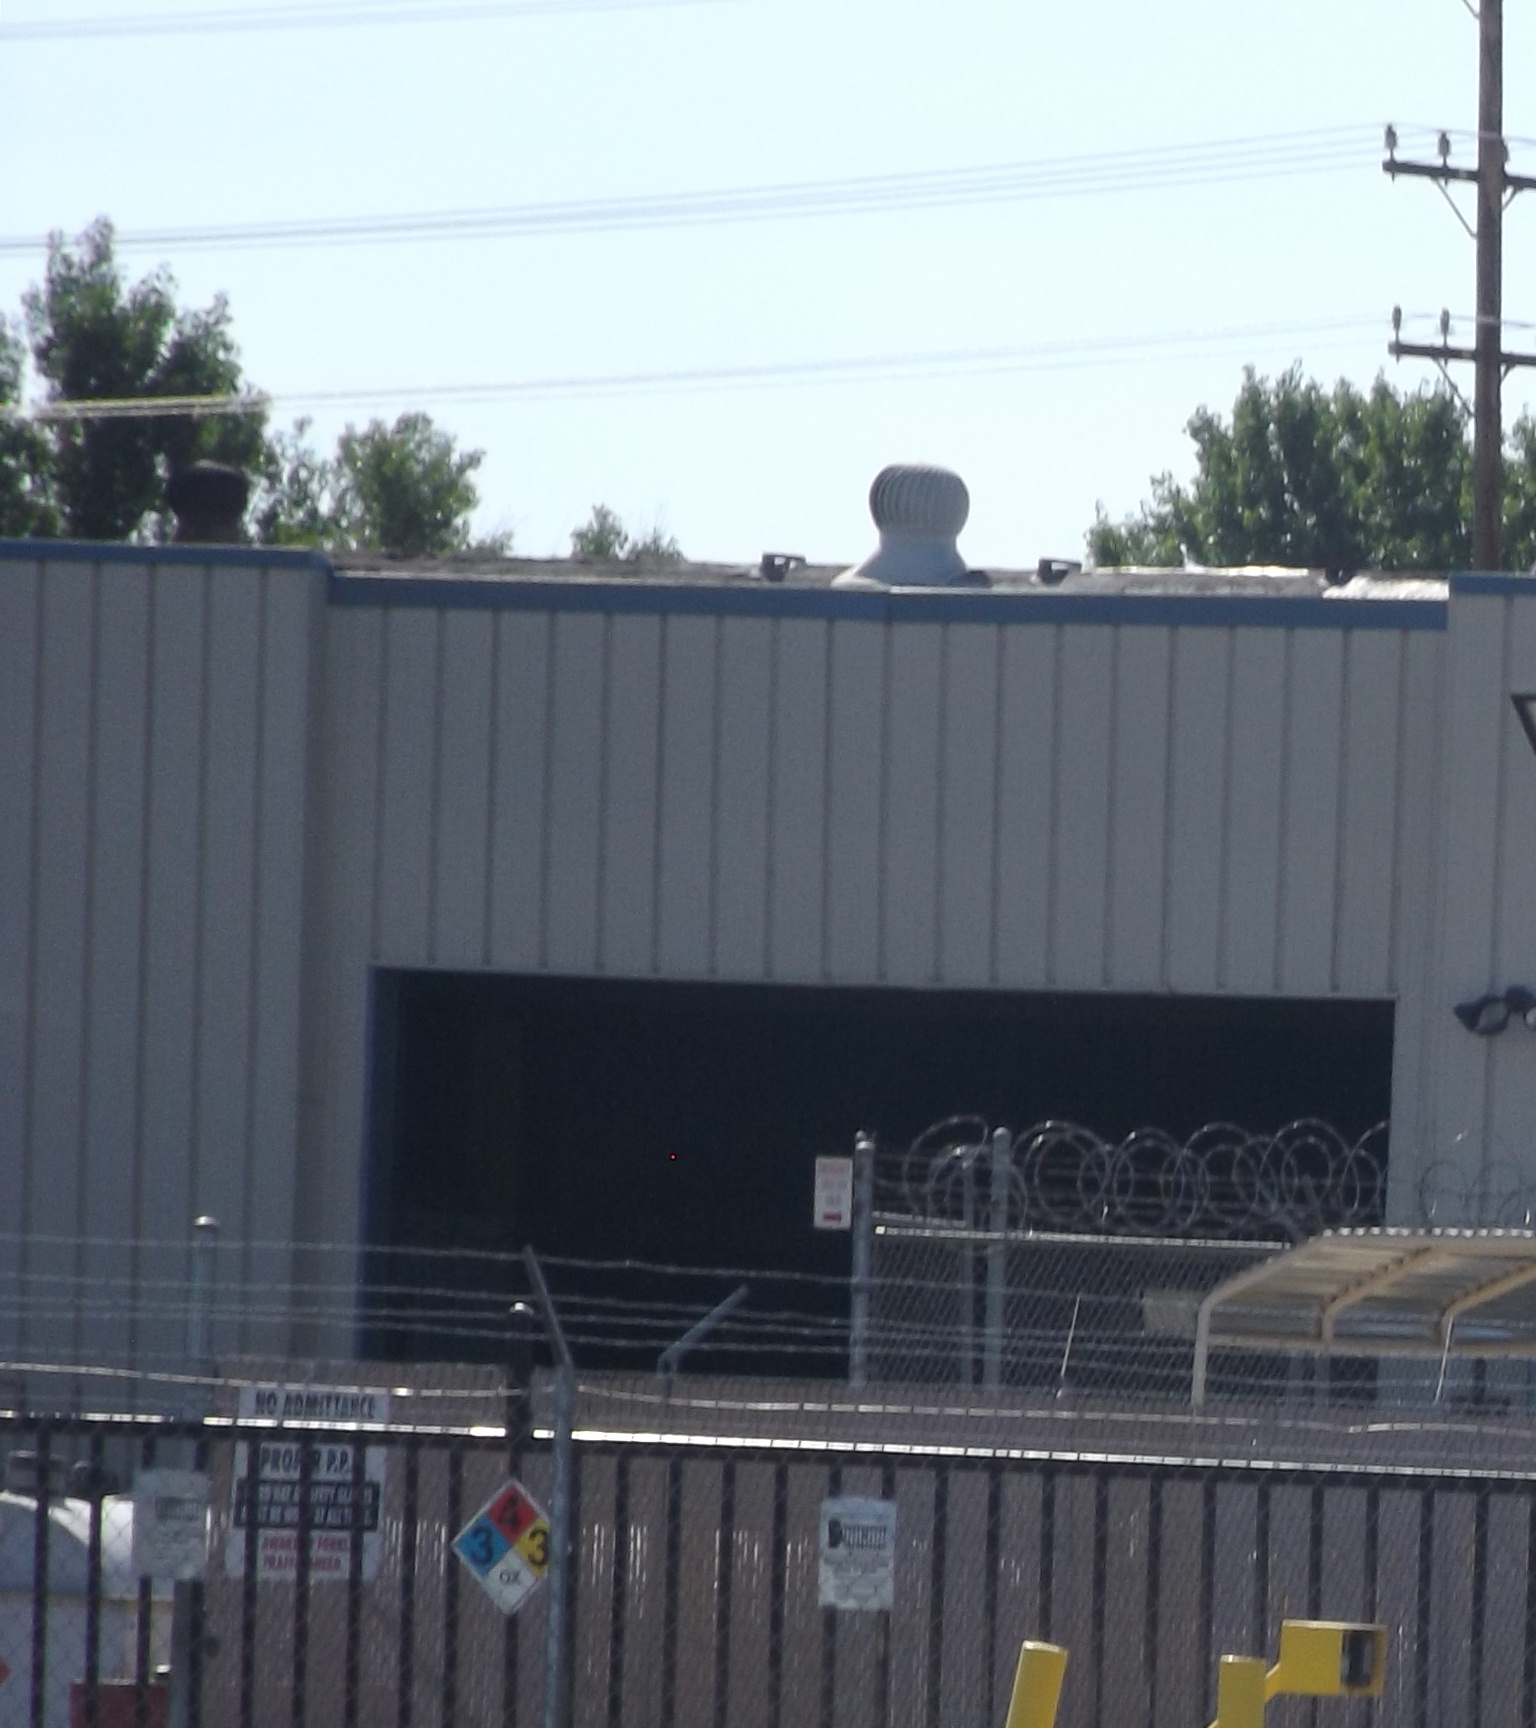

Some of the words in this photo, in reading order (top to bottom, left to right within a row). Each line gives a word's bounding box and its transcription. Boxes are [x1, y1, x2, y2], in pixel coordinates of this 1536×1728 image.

[255, 1391, 277, 1415] NO
[283, 1392, 375, 1419] ADMITTANCE
[497, 1493, 522, 1527] 4
[469, 1525, 495, 1566] 3
[528, 1527, 550, 1567] 3
